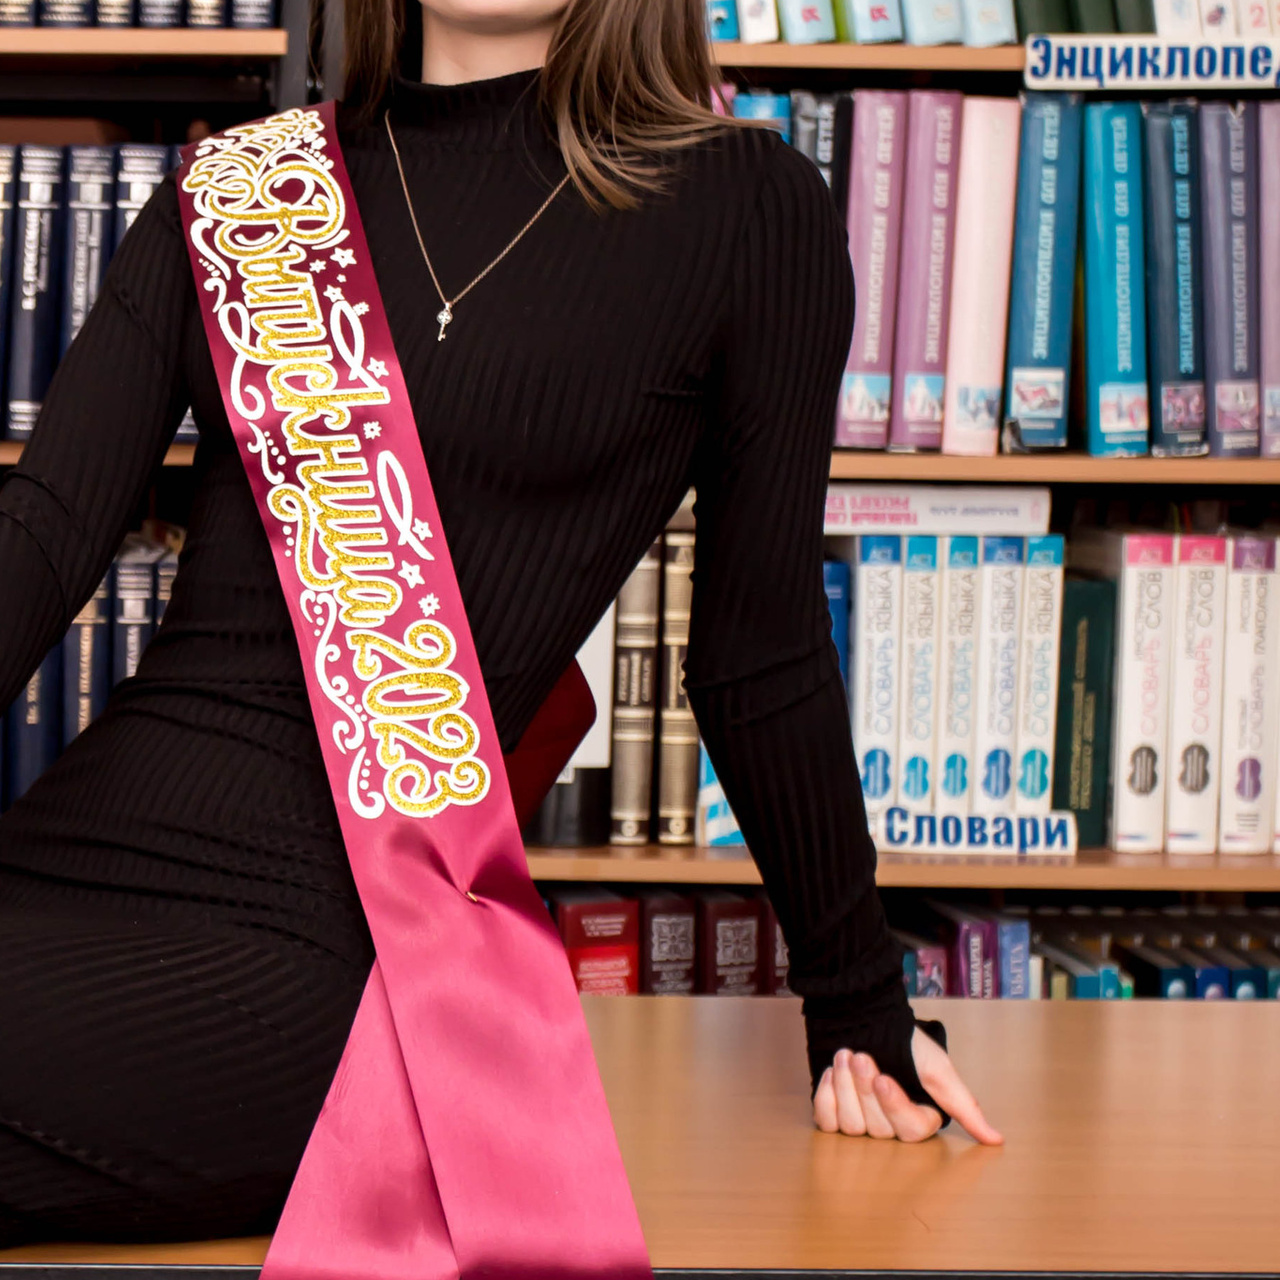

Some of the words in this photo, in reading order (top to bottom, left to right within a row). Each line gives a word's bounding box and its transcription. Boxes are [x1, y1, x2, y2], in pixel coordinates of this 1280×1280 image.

[802, 7, 820, 24] Я
[870, 5, 889, 23] Я
[1251, 4, 1266, 28] 2
[1031, 37, 1280, 89] Энциклопе
[877, 106, 895, 164] ДЕТЕЙ
[936, 106, 952, 164] ДЕТЕЙ
[1042, 103, 1059, 160] ДЕТЕЙ
[1111, 116, 1127, 172] ДЕТЕЙ
[1171, 115, 1188, 174] ДЕТЕЙ
[1230, 111, 1244, 172] ДЕТЕЙ
[876, 170, 891, 208] ДЛЯ
[934, 172, 948, 208] ДЛЯ
[1041, 167, 1056, 204] ДЛЯ
[1114, 181, 1129, 216] ДЛЯ
[1175, 178, 1190, 218] ДЛЯ
[1230, 177, 1245, 216] ДЛЯ
[864, 213, 887, 363] ЭНЦИКЛОПЕДИЯ
[926, 213, 947, 363] ЭНЦИКЛОПЕДИЯ
[1033, 210, 1055, 360] ЭНЦИКЛОПЕДИЯ
[1115, 224, 1132, 372] ЭНЦИКЛОПЕДИЯ
[1177, 223, 1194, 374] ЭНЦИКЛОПЕДИЯ
[1231, 221, 1248, 372] ЭНЦИКЛОПЕДИЯ
[203, 150, 402, 627] Выпускница
[877, 569, 891, 632] ЯЗЫКА
[918, 574, 934, 638] ЯЗЫКА
[960, 573, 975, 635] ЯЗЫКА
[1000, 570, 1016, 632] ЯЗЫКА
[1036, 571, 1053, 634] ЯЗЫКА
[1146, 572, 1162, 629] СЛОВ
[1197, 570, 1214, 628] СЛОВ
[1252, 577, 1267, 655] ГЛАГОЛОВ
[875, 638, 892, 735] СЛОВАРЬ
[915, 641, 932, 740] СЛОВАРЬ
[955, 640, 972, 737] СЛОВАРЬ
[998, 637, 1015, 735] СЛОВАРЬ
[1032, 640, 1051, 736] СЛОВАРЬ
[1140, 639, 1160, 736] СЛОВАРЬ
[1192, 636, 1211, 733] СЛОВАРЬ
[1249, 663, 1264, 750] СЛОВАРЬ
[346, 620, 492, 818] 2023
[885, 807, 1069, 855] Словари
[1011, 944, 1023, 995] БЫТА
